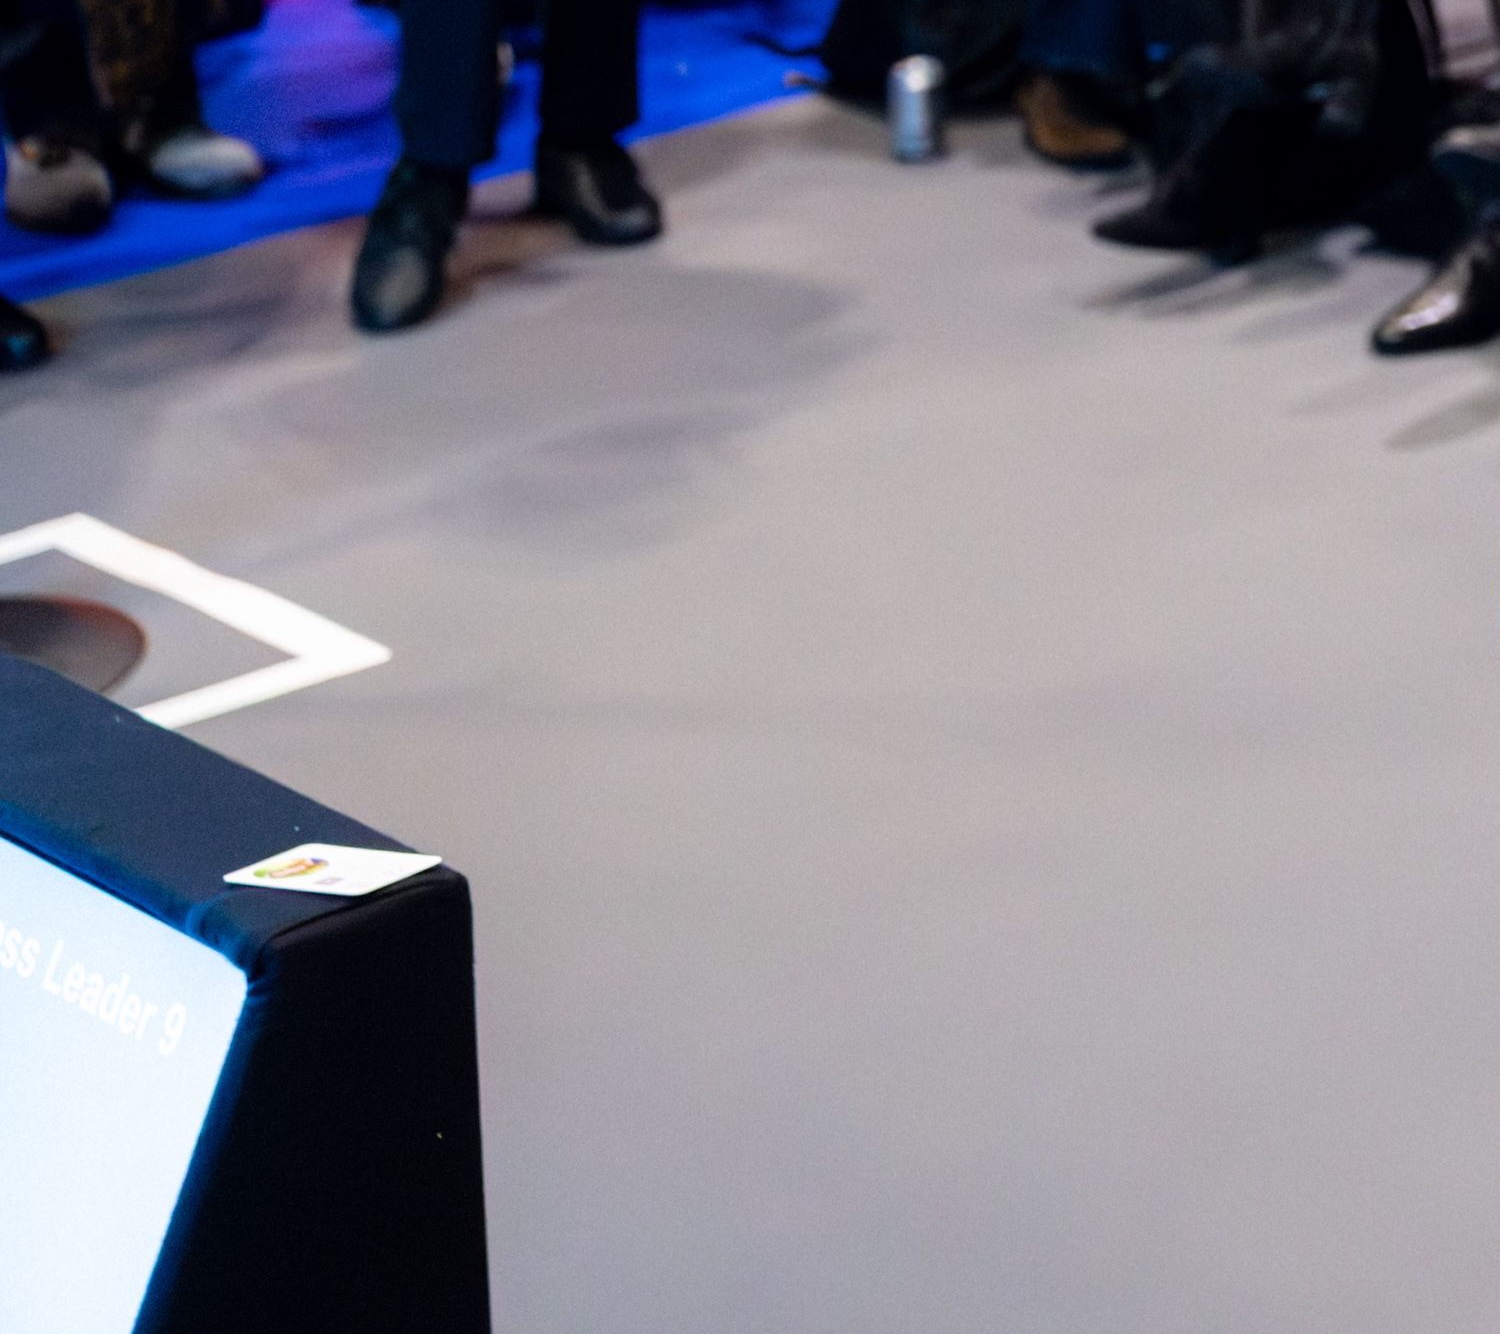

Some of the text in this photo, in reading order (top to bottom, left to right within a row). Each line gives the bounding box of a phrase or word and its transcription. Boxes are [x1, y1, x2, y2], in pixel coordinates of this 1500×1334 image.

[0, 917, 187, 1056] ss Leader 9
